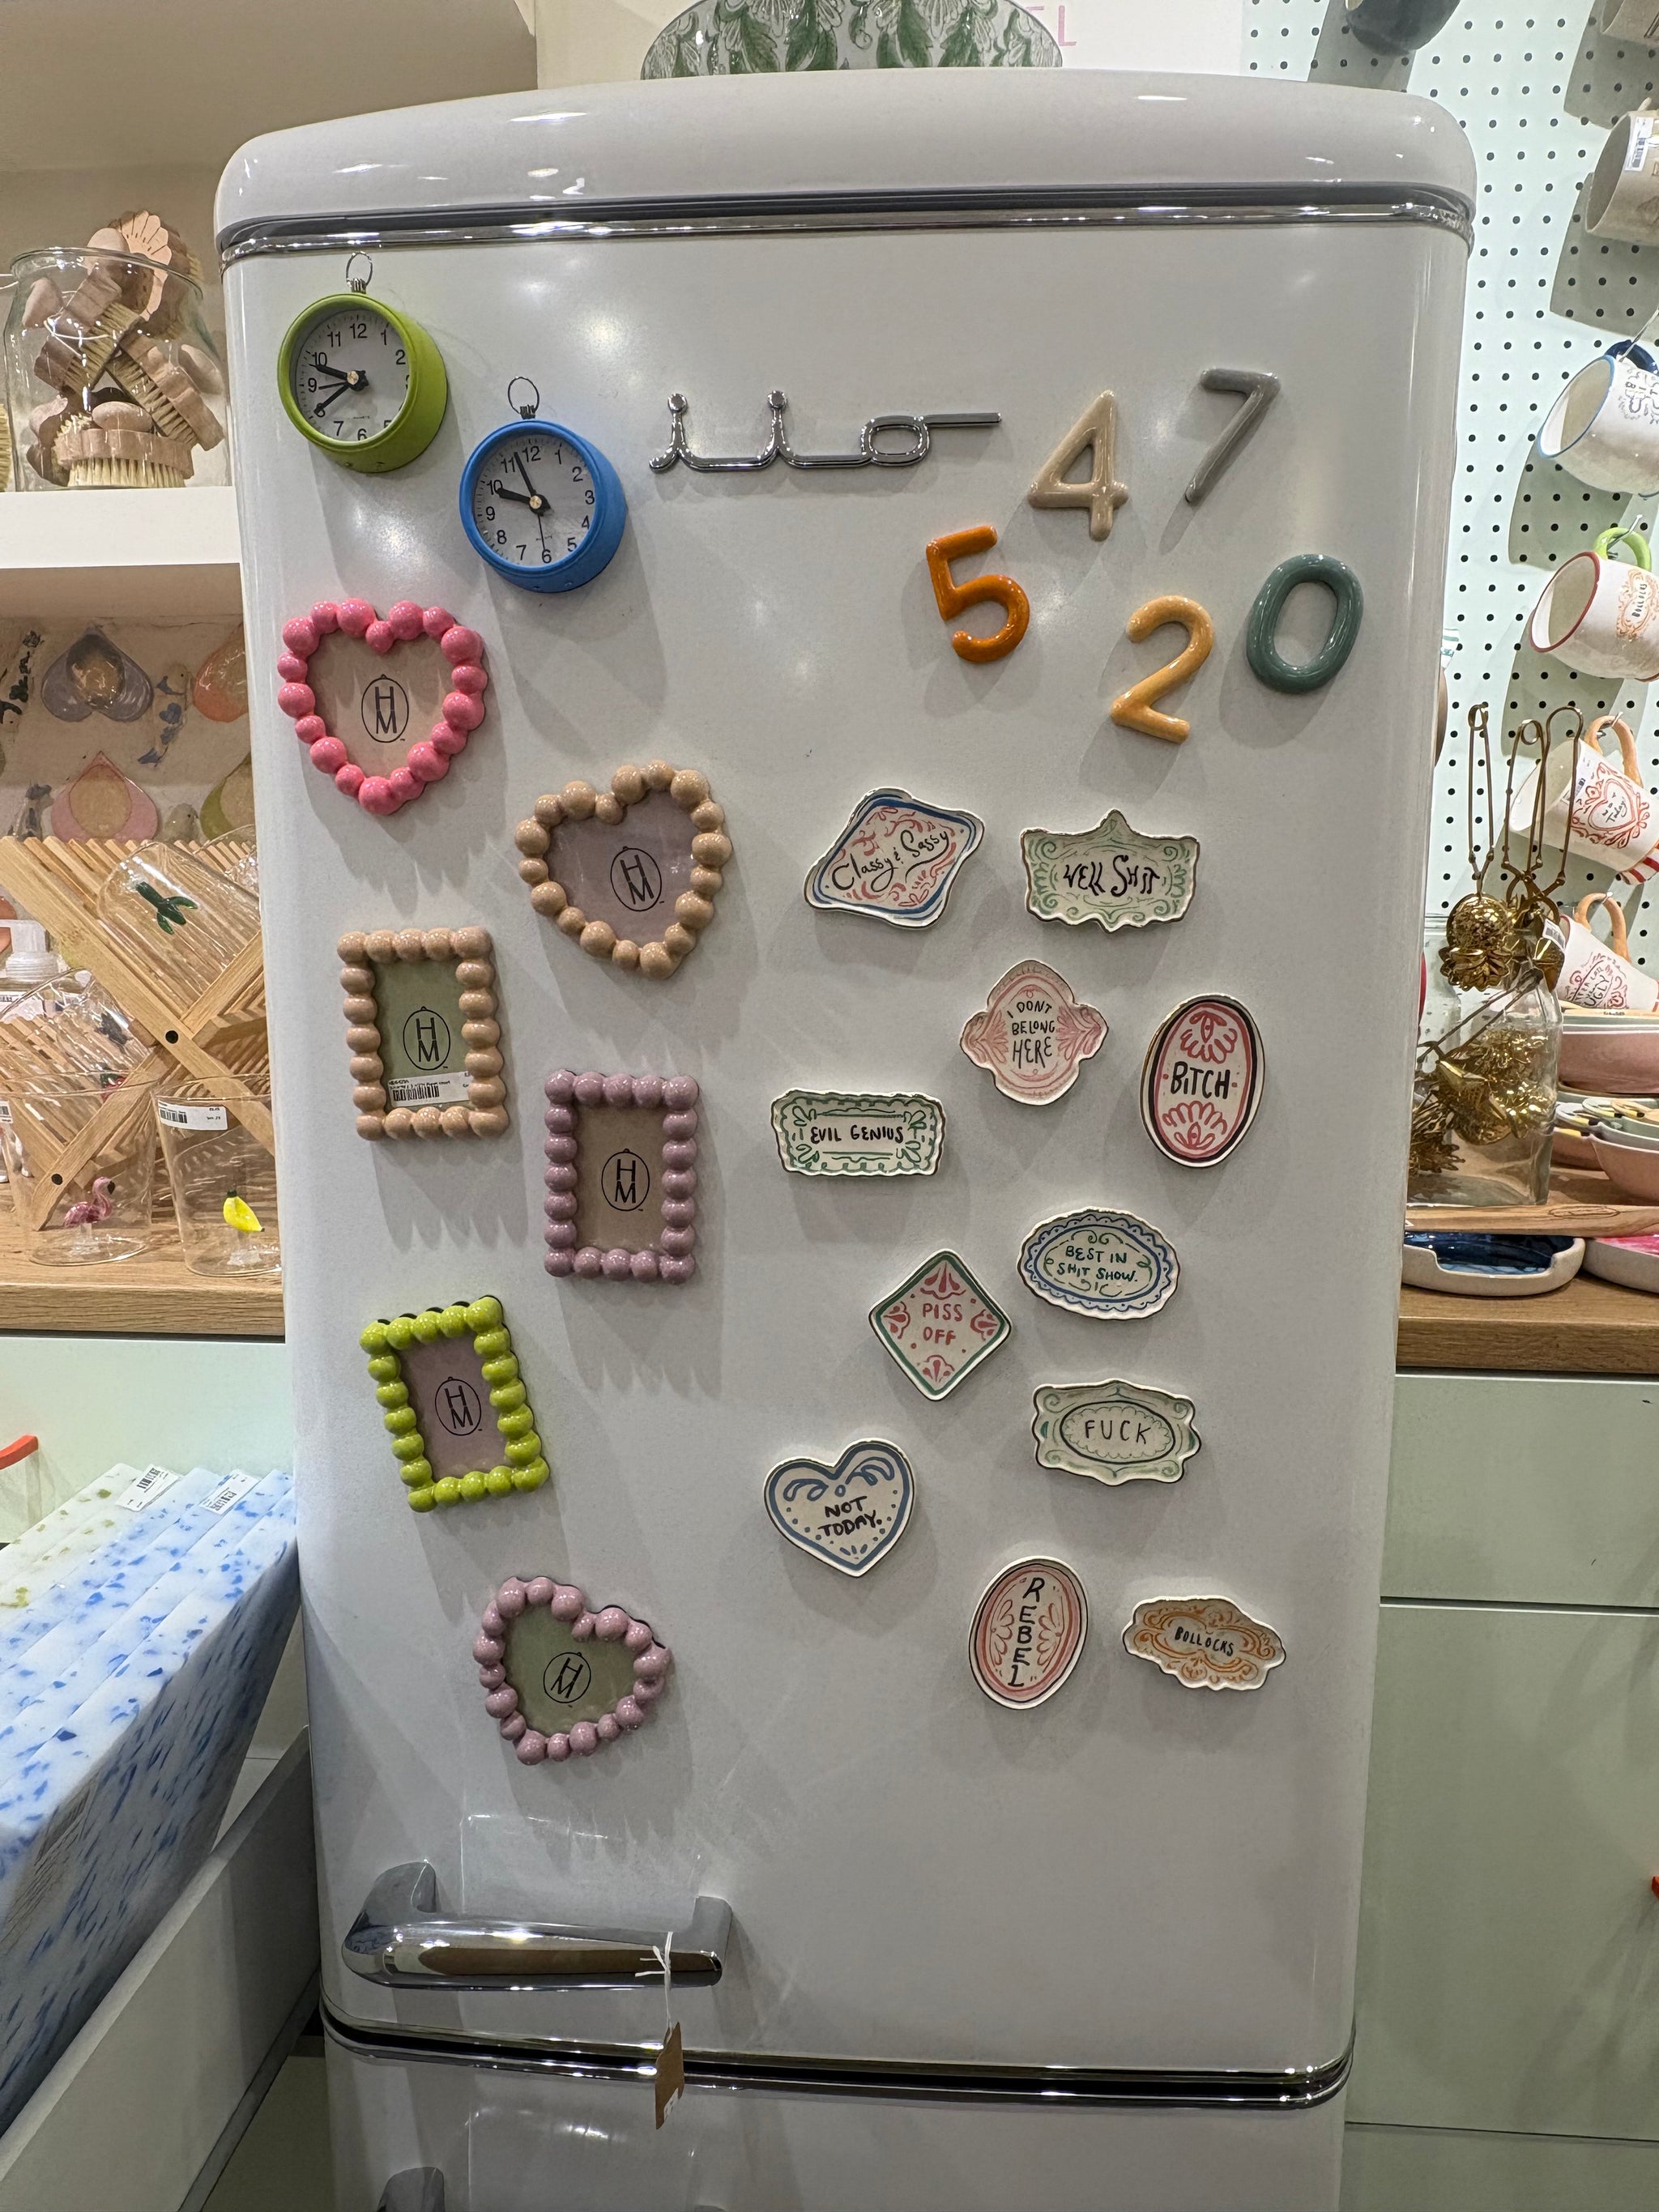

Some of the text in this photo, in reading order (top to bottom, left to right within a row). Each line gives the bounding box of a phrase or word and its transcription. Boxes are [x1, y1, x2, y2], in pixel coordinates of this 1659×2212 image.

[327, 330, 341, 347] 11
[350, 323, 368, 339] 12
[381, 329, 387, 345] 1
[395, 349, 406, 364] 2
[308, 377, 318, 393] 9
[333, 421, 344, 436] 7
[522, 445, 541, 462] 12
[554, 450, 562, 465] 1
[501, 457, 515, 473] 11
[1027, 390, 1129, 542] 4
[572, 467, 583, 482] 2
[585, 490, 595, 505] 3
[486, 506, 496, 521] 9
[582, 515, 590, 530] 4
[497, 530, 507, 544] 8
[567, 538, 577, 552] 5
[516, 545, 527, 560] 7
[541, 549, 552, 564] 6
[926, 526, 1030, 663] 5
[1111, 595, 1213, 744] 2
[832, 853, 898, 892] Classy
[901, 830, 949, 883] Sassy
[1017, 1000, 1052, 1013] DONT
[1012, 1020, 1055, 1035] BELONG
[1013, 1037, 1052, 1069] HERE
[810, 1124, 903, 1144] EVIL GENIUS
[1066, 1246, 1128, 1264] BEST IN
[1057, 1263, 1090, 1278] SHIT
[922, 1302, 962, 1321] PISS
[923, 1327, 957, 1345] OFF
[1084, 1419, 1151, 1444] FUCK
[825, 1496, 868, 1517] NOT
[1007, 1577, 1045, 1687] REBEL
[1175, 1626, 1234, 1656] BOLLOCKS
